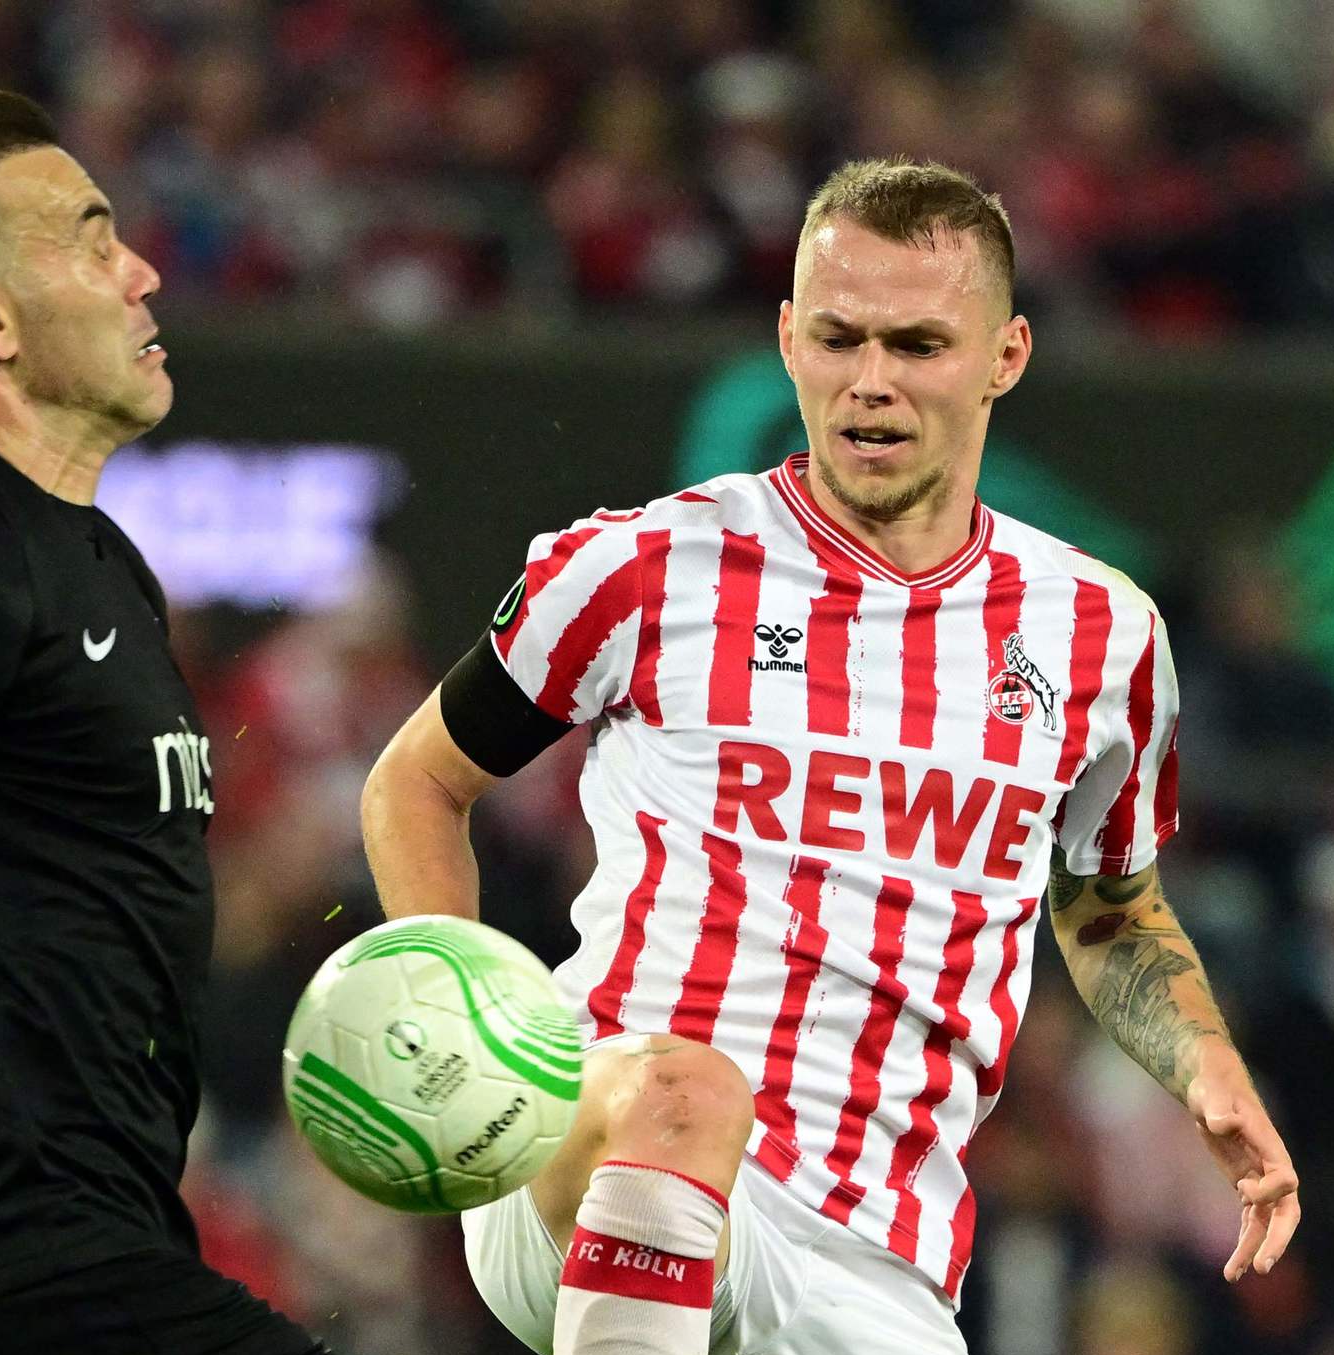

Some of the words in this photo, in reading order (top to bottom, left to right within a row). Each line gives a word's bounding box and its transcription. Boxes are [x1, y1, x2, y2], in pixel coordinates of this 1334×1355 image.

[748, 656, 809, 674] hummel
[713, 740, 1046, 881] REWE
[455, 1096, 527, 1166] molten
[578, 1241, 604, 1262] FC
[612, 1246, 686, 1282] KÖLN
